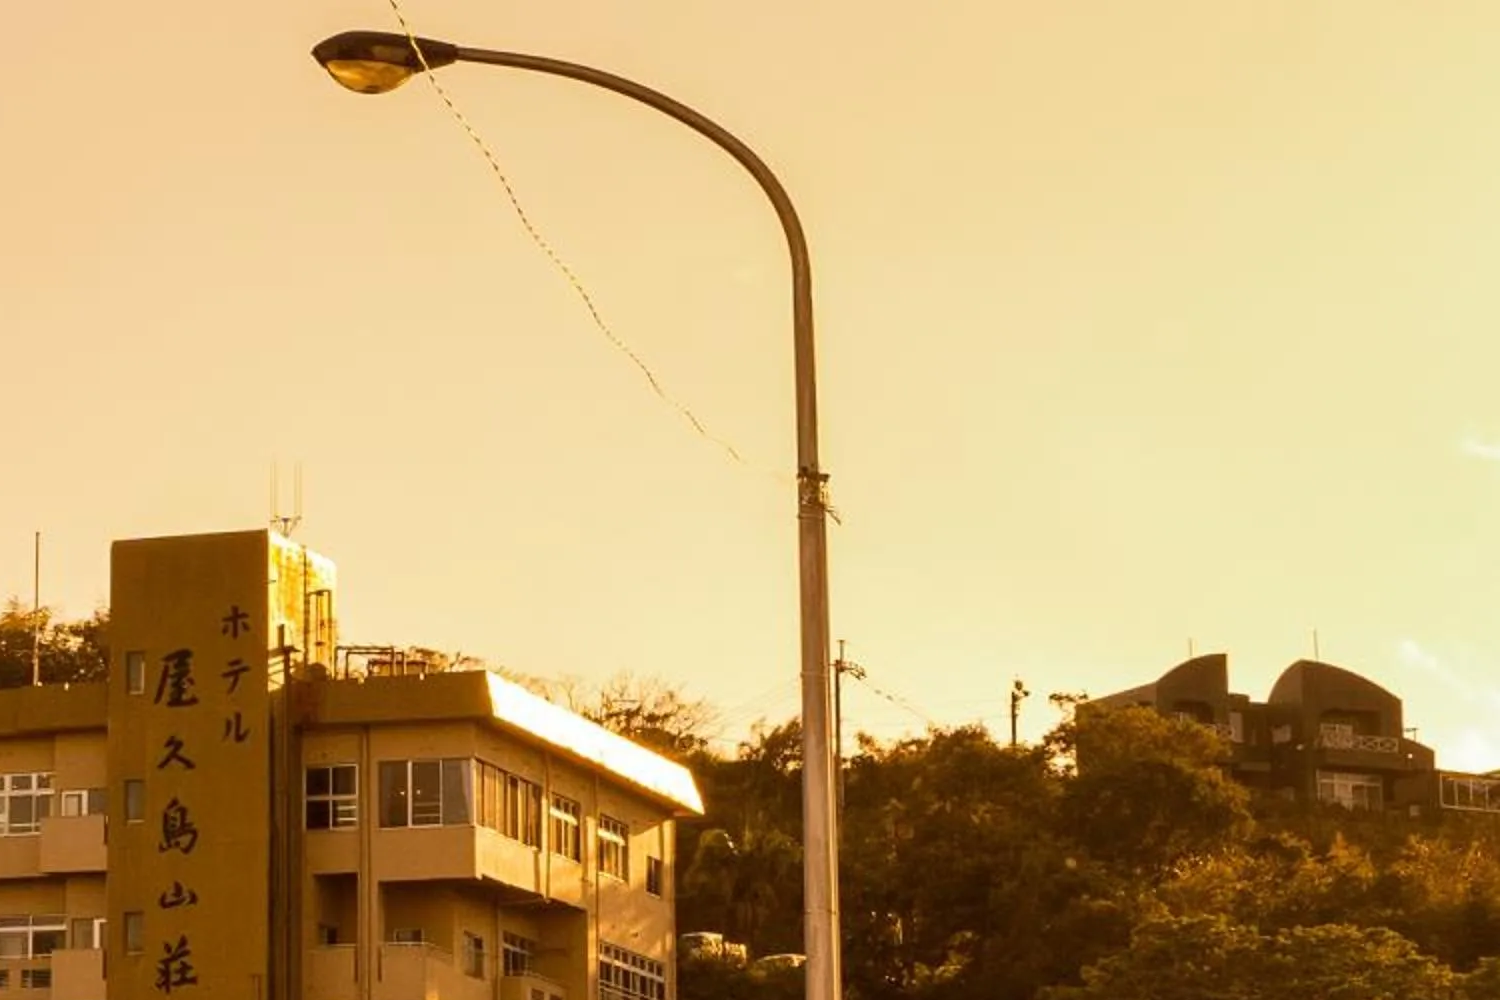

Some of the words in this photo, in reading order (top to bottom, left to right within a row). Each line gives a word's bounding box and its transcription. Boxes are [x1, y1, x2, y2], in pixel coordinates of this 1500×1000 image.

[221, 605, 250, 743] ホテル
[153, 648, 199, 995] 屋久島山荘
